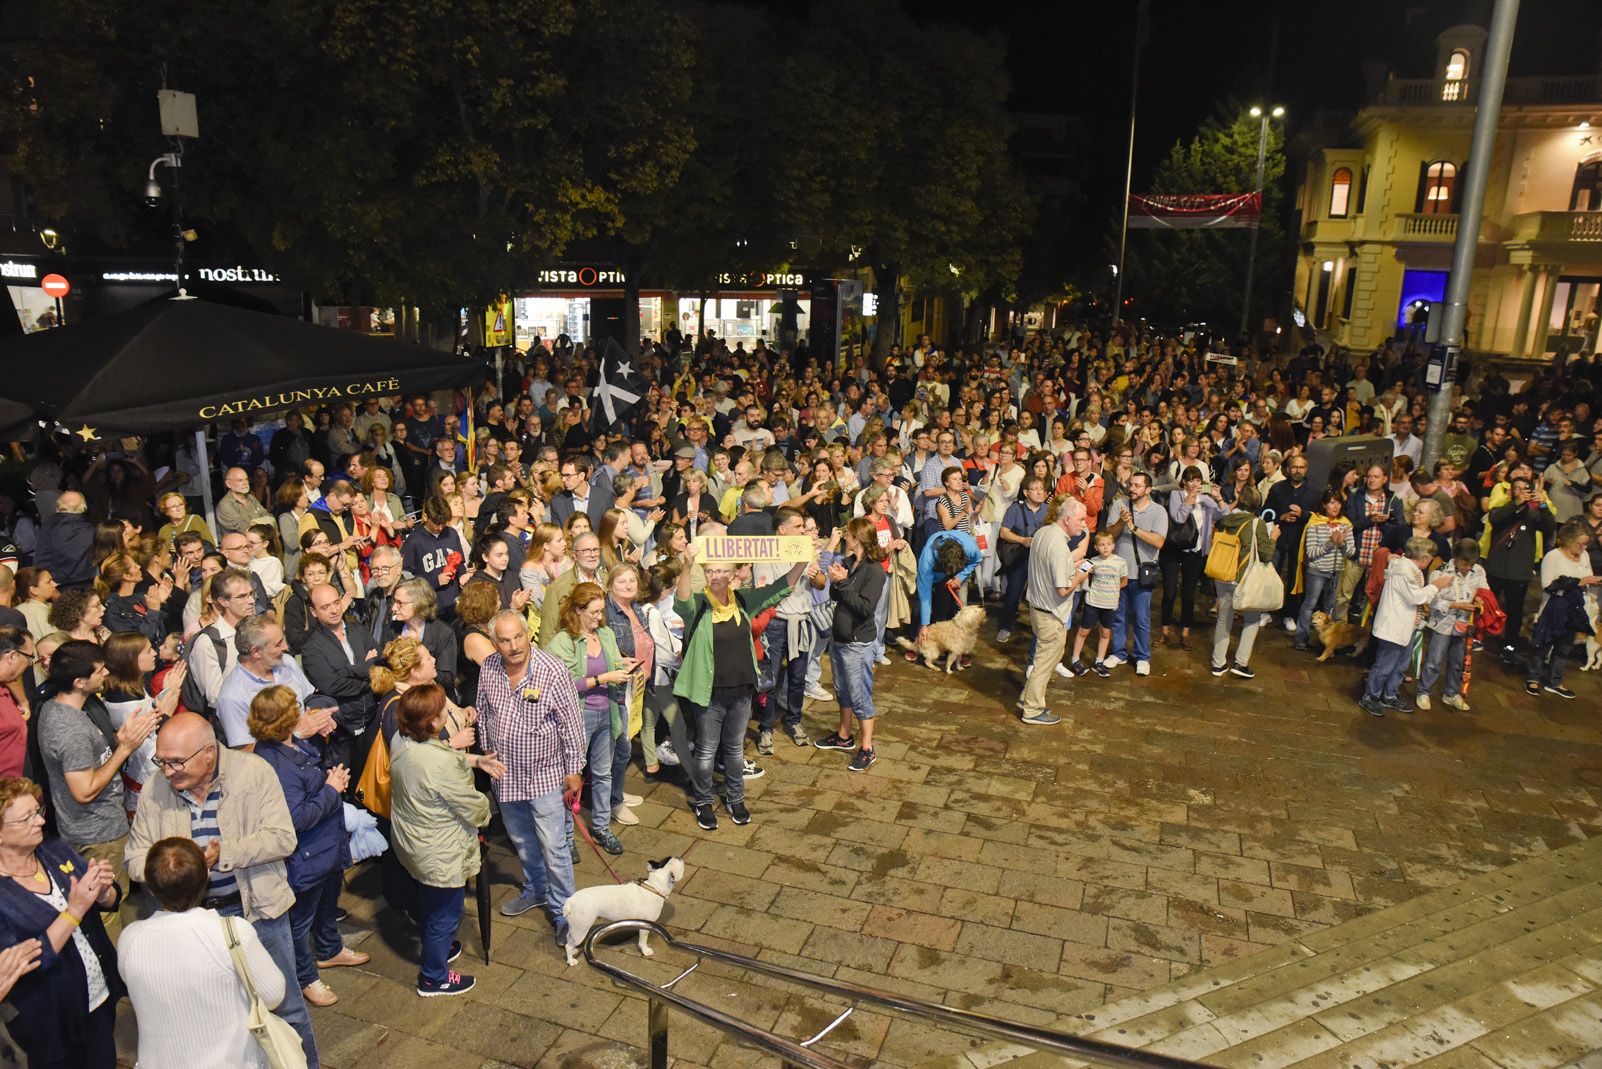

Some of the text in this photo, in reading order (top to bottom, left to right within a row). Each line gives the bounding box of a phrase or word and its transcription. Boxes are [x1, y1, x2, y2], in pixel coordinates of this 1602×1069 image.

[198, 377, 401, 419] CATALUNYA CAFÈ
[705, 537, 780, 558] LLIBERTAT!
[422, 548, 455, 573] GA
